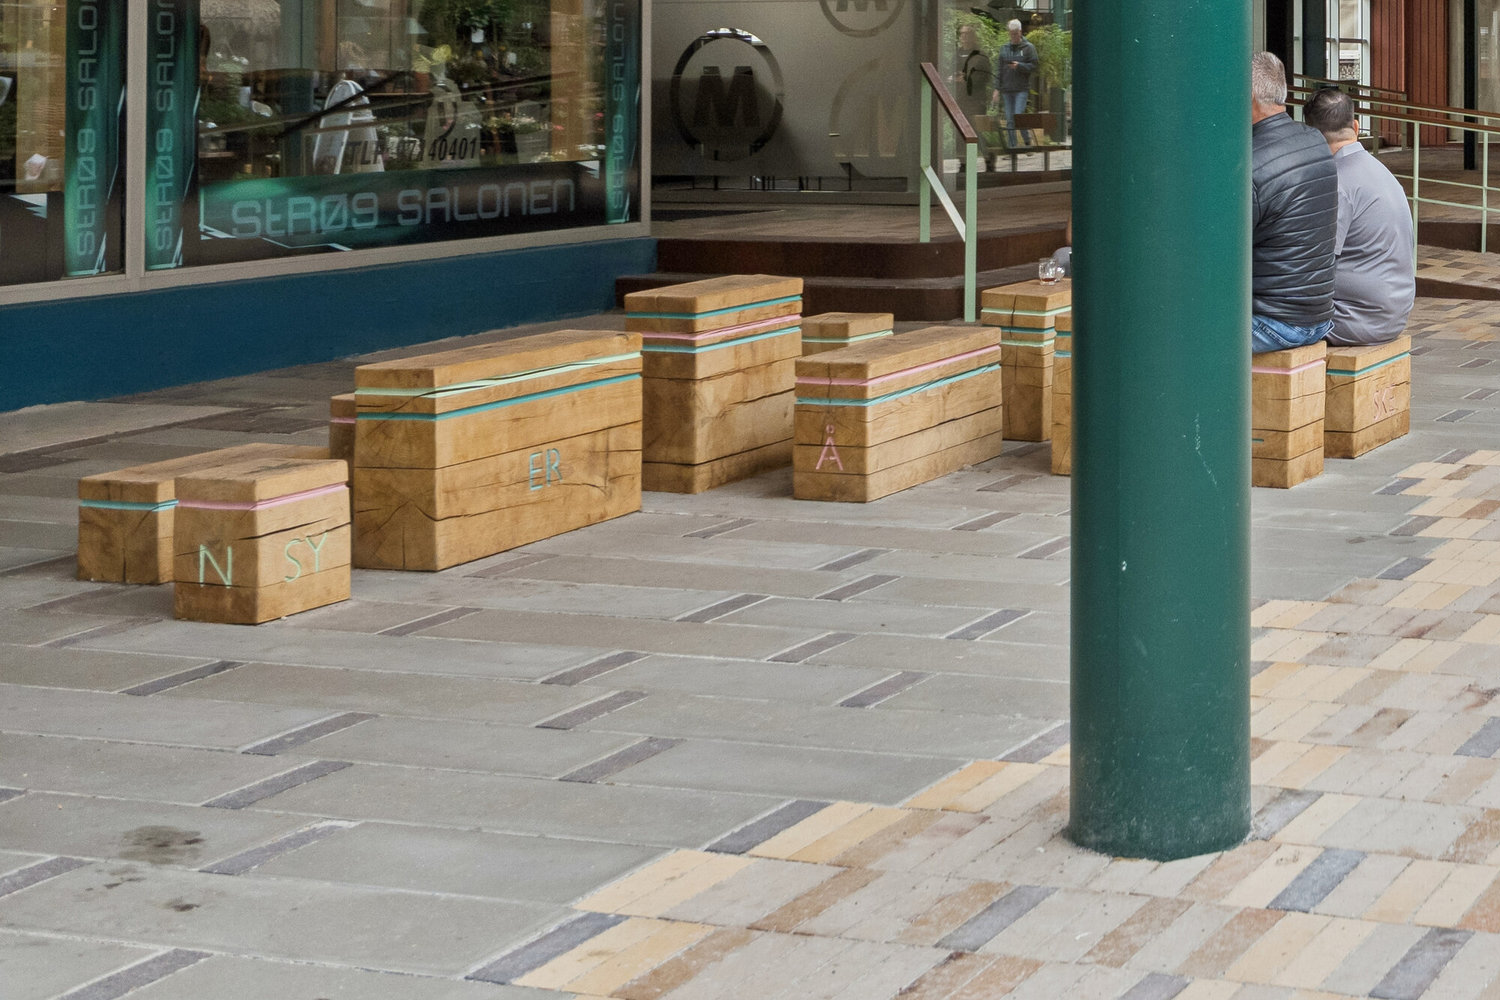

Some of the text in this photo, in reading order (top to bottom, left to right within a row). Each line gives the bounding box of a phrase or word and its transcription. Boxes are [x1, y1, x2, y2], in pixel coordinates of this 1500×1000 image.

[529, 447, 563, 491] ER
[815, 424, 844, 471] Å
[199, 543, 234, 589] N
[284, 531, 329, 583] SY
